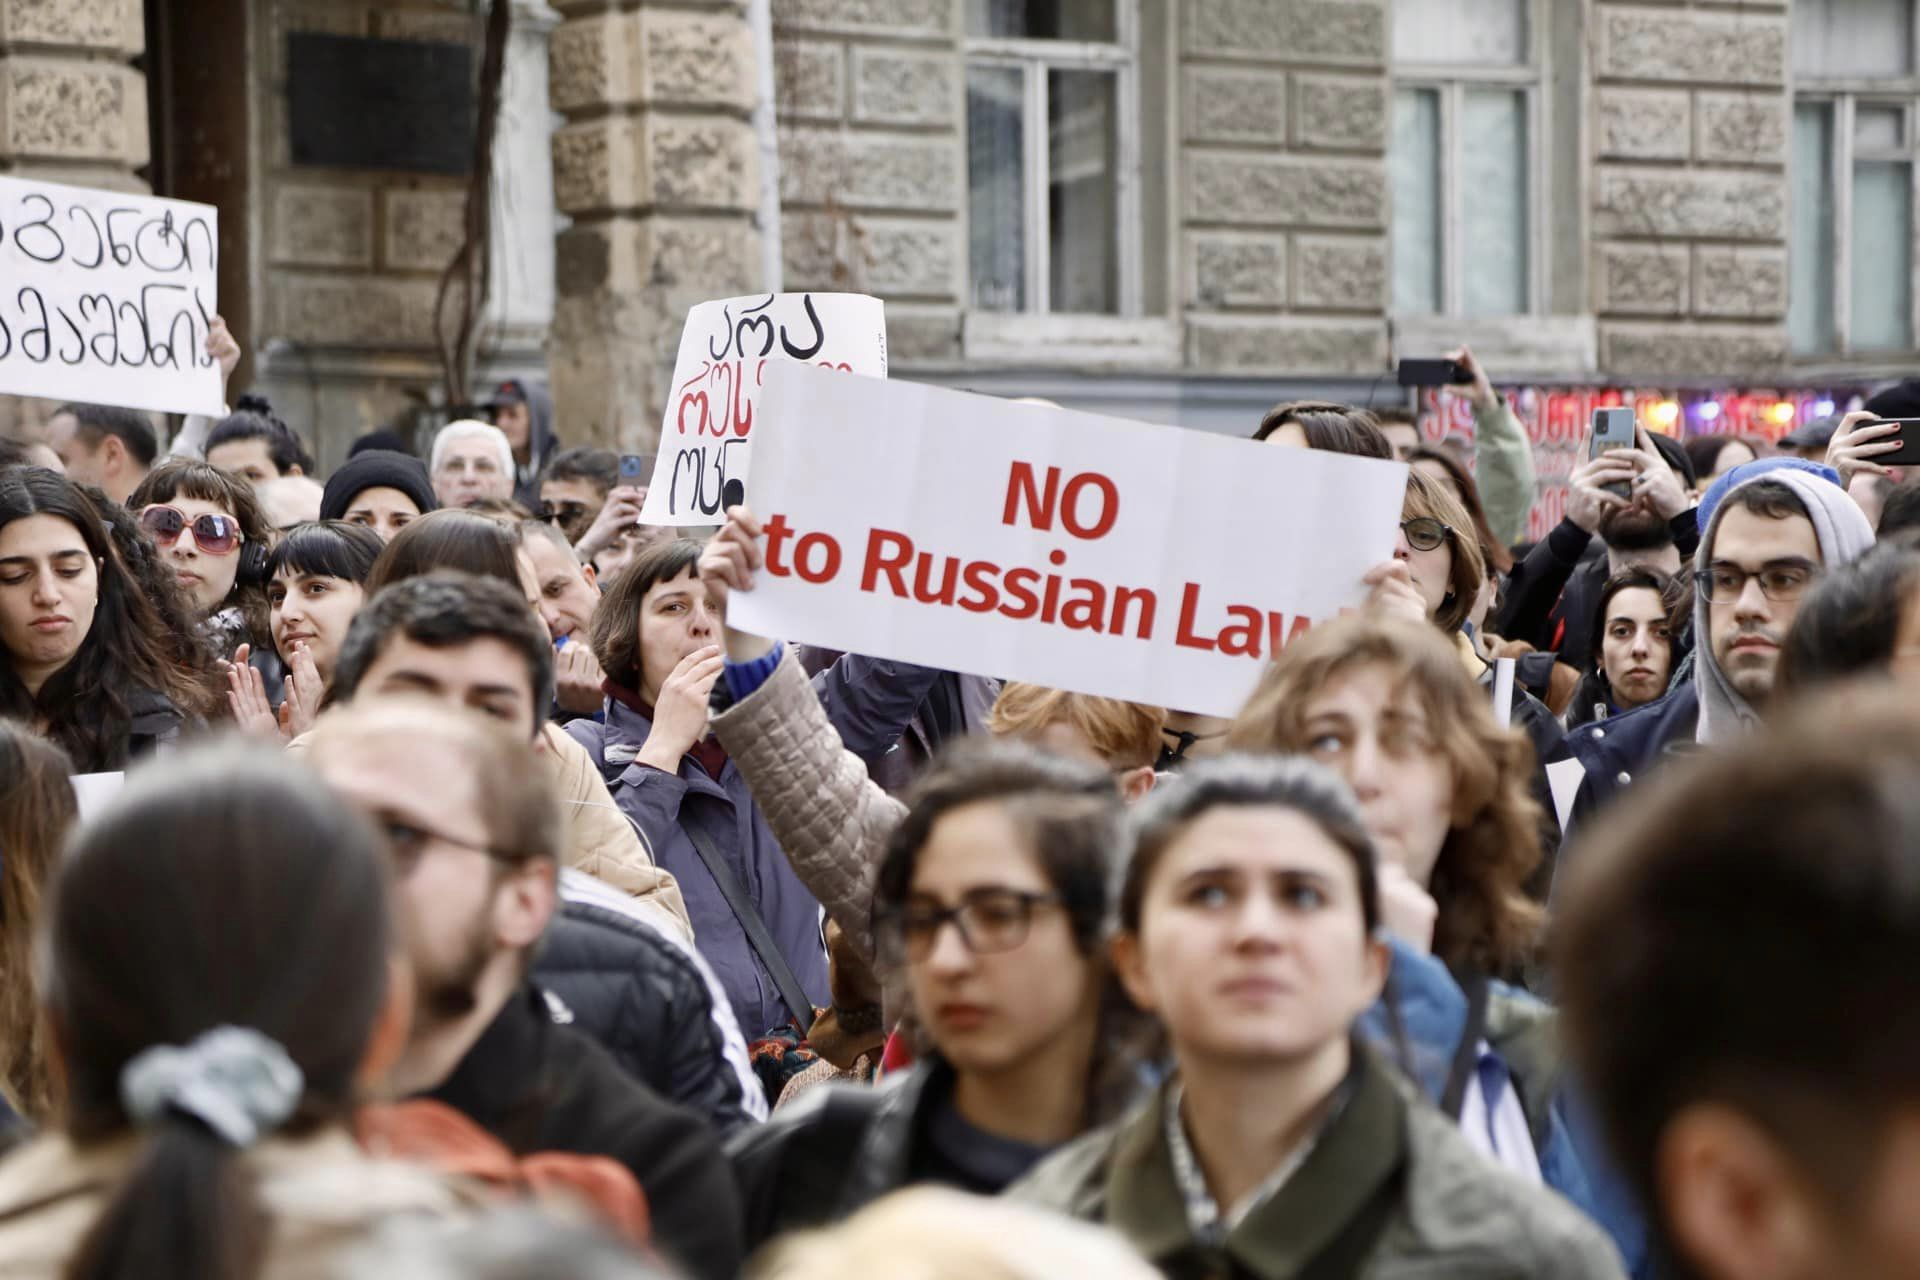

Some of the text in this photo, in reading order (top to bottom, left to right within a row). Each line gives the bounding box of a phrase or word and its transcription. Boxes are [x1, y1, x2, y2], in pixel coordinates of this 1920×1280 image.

[0, 193, 214, 271] გენტი
[709, 293, 824, 361] არა
[1002, 461, 1119, 540] NO
[762, 514, 1358, 661] to Russian Law
